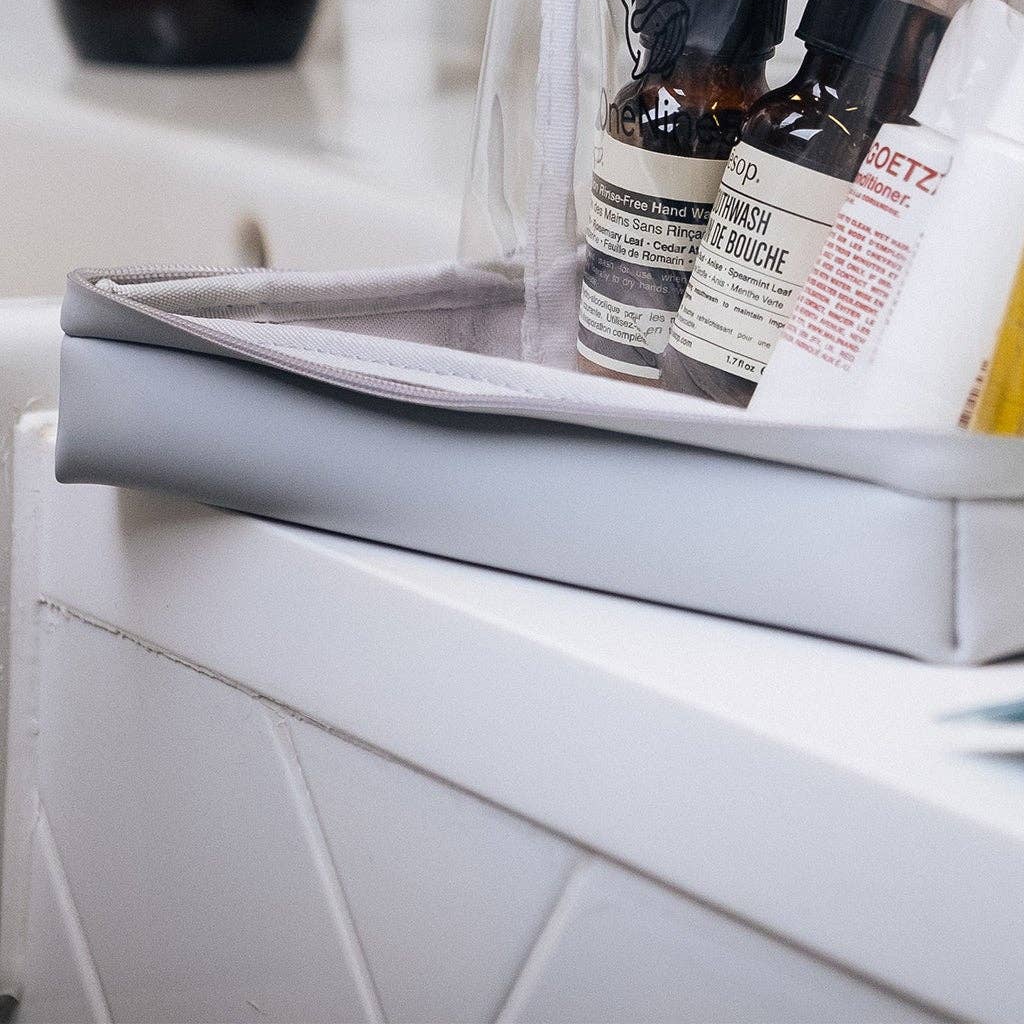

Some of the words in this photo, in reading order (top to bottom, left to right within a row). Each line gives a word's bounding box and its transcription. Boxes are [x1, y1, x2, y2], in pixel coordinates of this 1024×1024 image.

[600, 184, 648, 212] Rinse-Free
[651, 201, 687, 218] Hand
[604, 207, 630, 227] Mains
[632, 218, 662, 235] Sans
[624, 234, 644, 247] Leaf
[653, 240, 686, 255] Cedar
[628, 248, 639, 259] de
[642, 250, 684, 266] Romarin
[711, 222, 727, 250] DE
[725, 228, 789, 275] BOUCHE
[728, 267, 770, 290] Spearmint
[771, 284, 793, 297] Leaf
[731, 283, 760, 301] Menthe
[762, 296, 784, 309] Verte
[722, 298, 729, 308] to
[733, 306, 764, 322] maintain
[745, 362, 756, 373] oz
